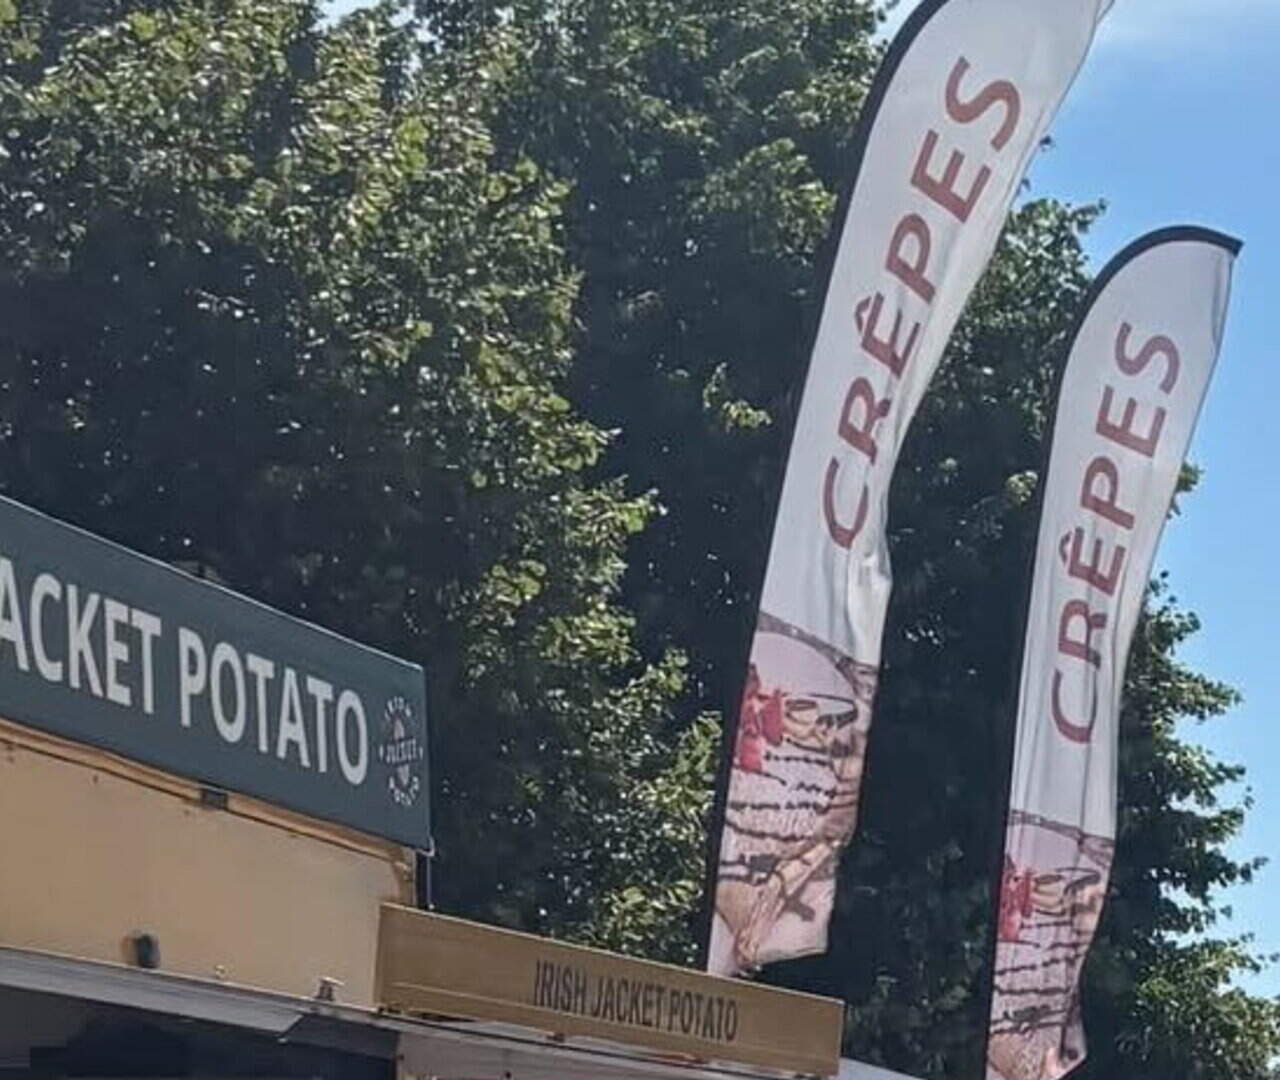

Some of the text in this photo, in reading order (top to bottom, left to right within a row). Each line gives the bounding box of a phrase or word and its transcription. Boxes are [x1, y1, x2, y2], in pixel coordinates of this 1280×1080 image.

[822, 56, 1021, 550] CRÊPES
[1051, 322, 1181, 745] CRÊPES
[177, 625, 370, 786] POTATO
[534, 959, 739, 1042] IRISH JACKET POTATO
